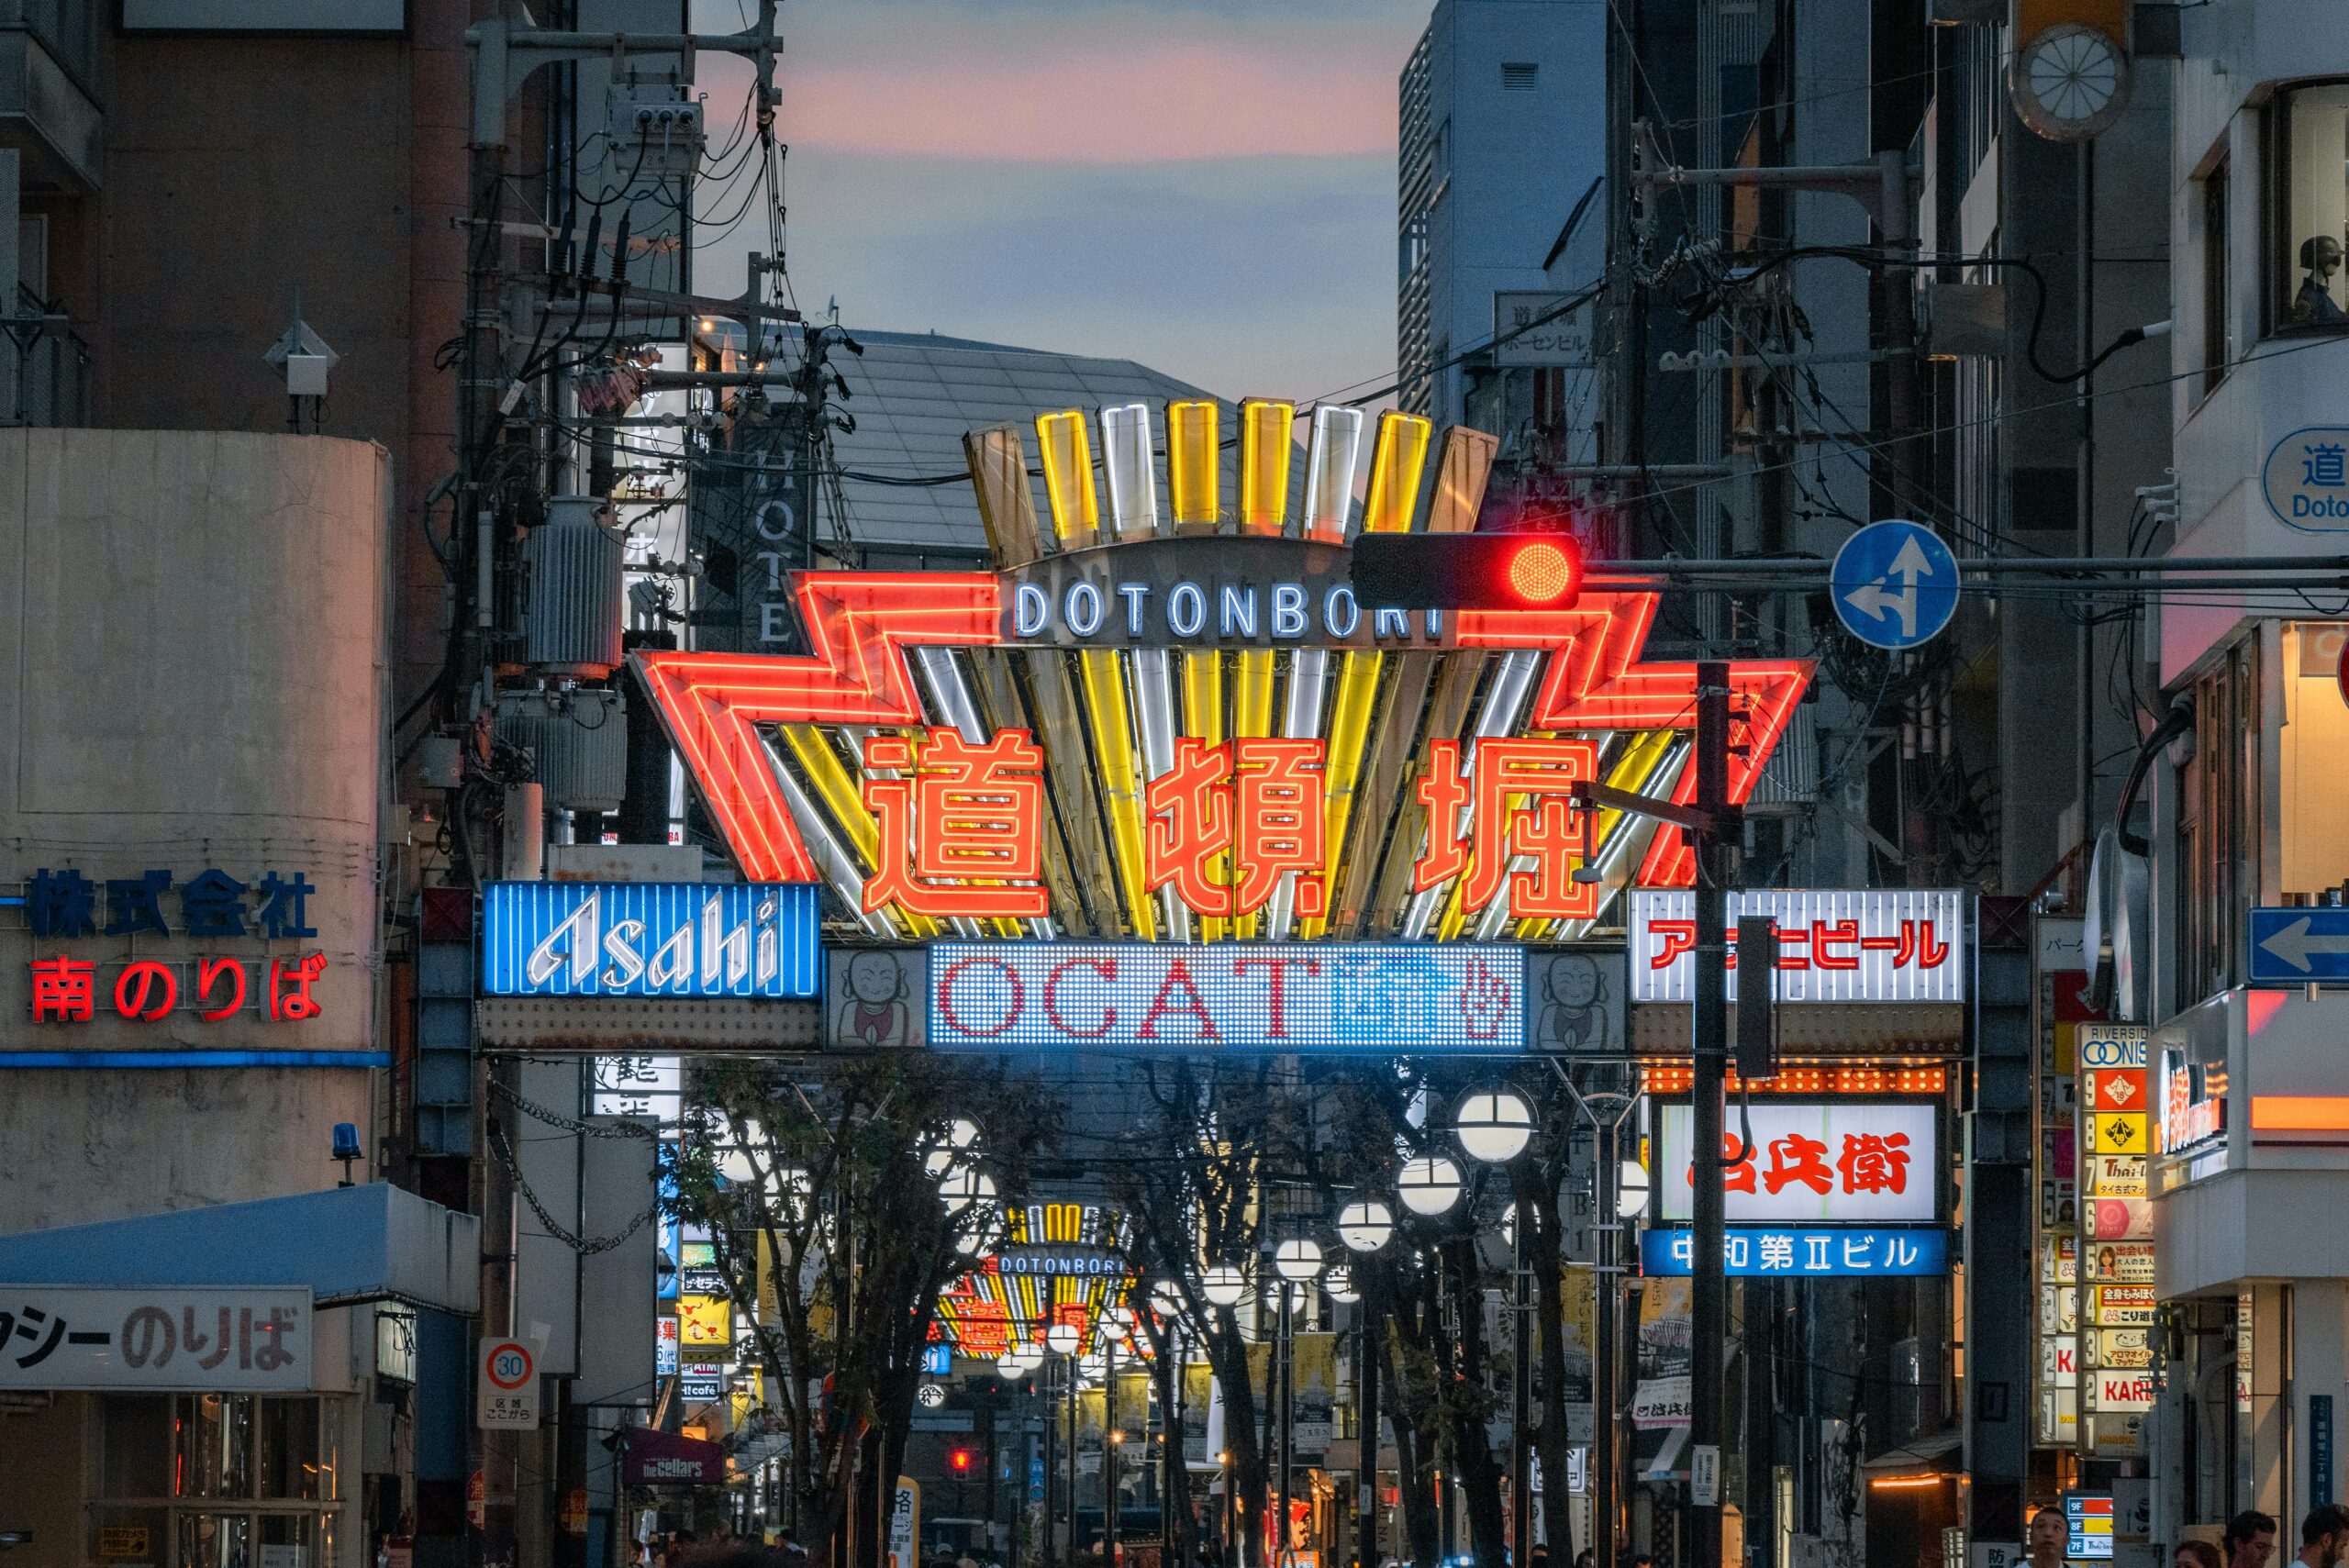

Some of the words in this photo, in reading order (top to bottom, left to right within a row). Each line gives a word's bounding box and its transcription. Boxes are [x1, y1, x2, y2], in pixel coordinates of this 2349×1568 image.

[2302, 442, 2346, 486] 道
[2292, 494, 2349, 518] Doto
[863, 727, 1598, 918] 道頓堀
[29, 867, 318, 939] 株式会社
[526, 890, 779, 990] Asahi
[30, 951, 328, 1024] 南のりば
[938, 957, 1320, 1038] OCAT
[2085, 1073, 2096, 1106] 9
[2086, 1116, 2096, 1150] 8
[2086, 1159, 2096, 1193] 7
[2086, 1202, 2096, 1236] 6
[1000, 1257, 1124, 1273] DOTONBORI
[2086, 1245, 2096, 1279] 5
[2086, 1288, 2096, 1322] 4
[2086, 1330, 2096, 1365] 3
[497, 1356, 523, 1377] 30
[2086, 1374, 2096, 1408] 2
[2086, 1418, 2095, 1450] 1
[2071, 1503, 2082, 1511] 9F
[2071, 1522, 2082, 1530] 8F
[1988, 1549, 2006, 1568] 防
[2071, 1542, 2082, 1551] 7F
